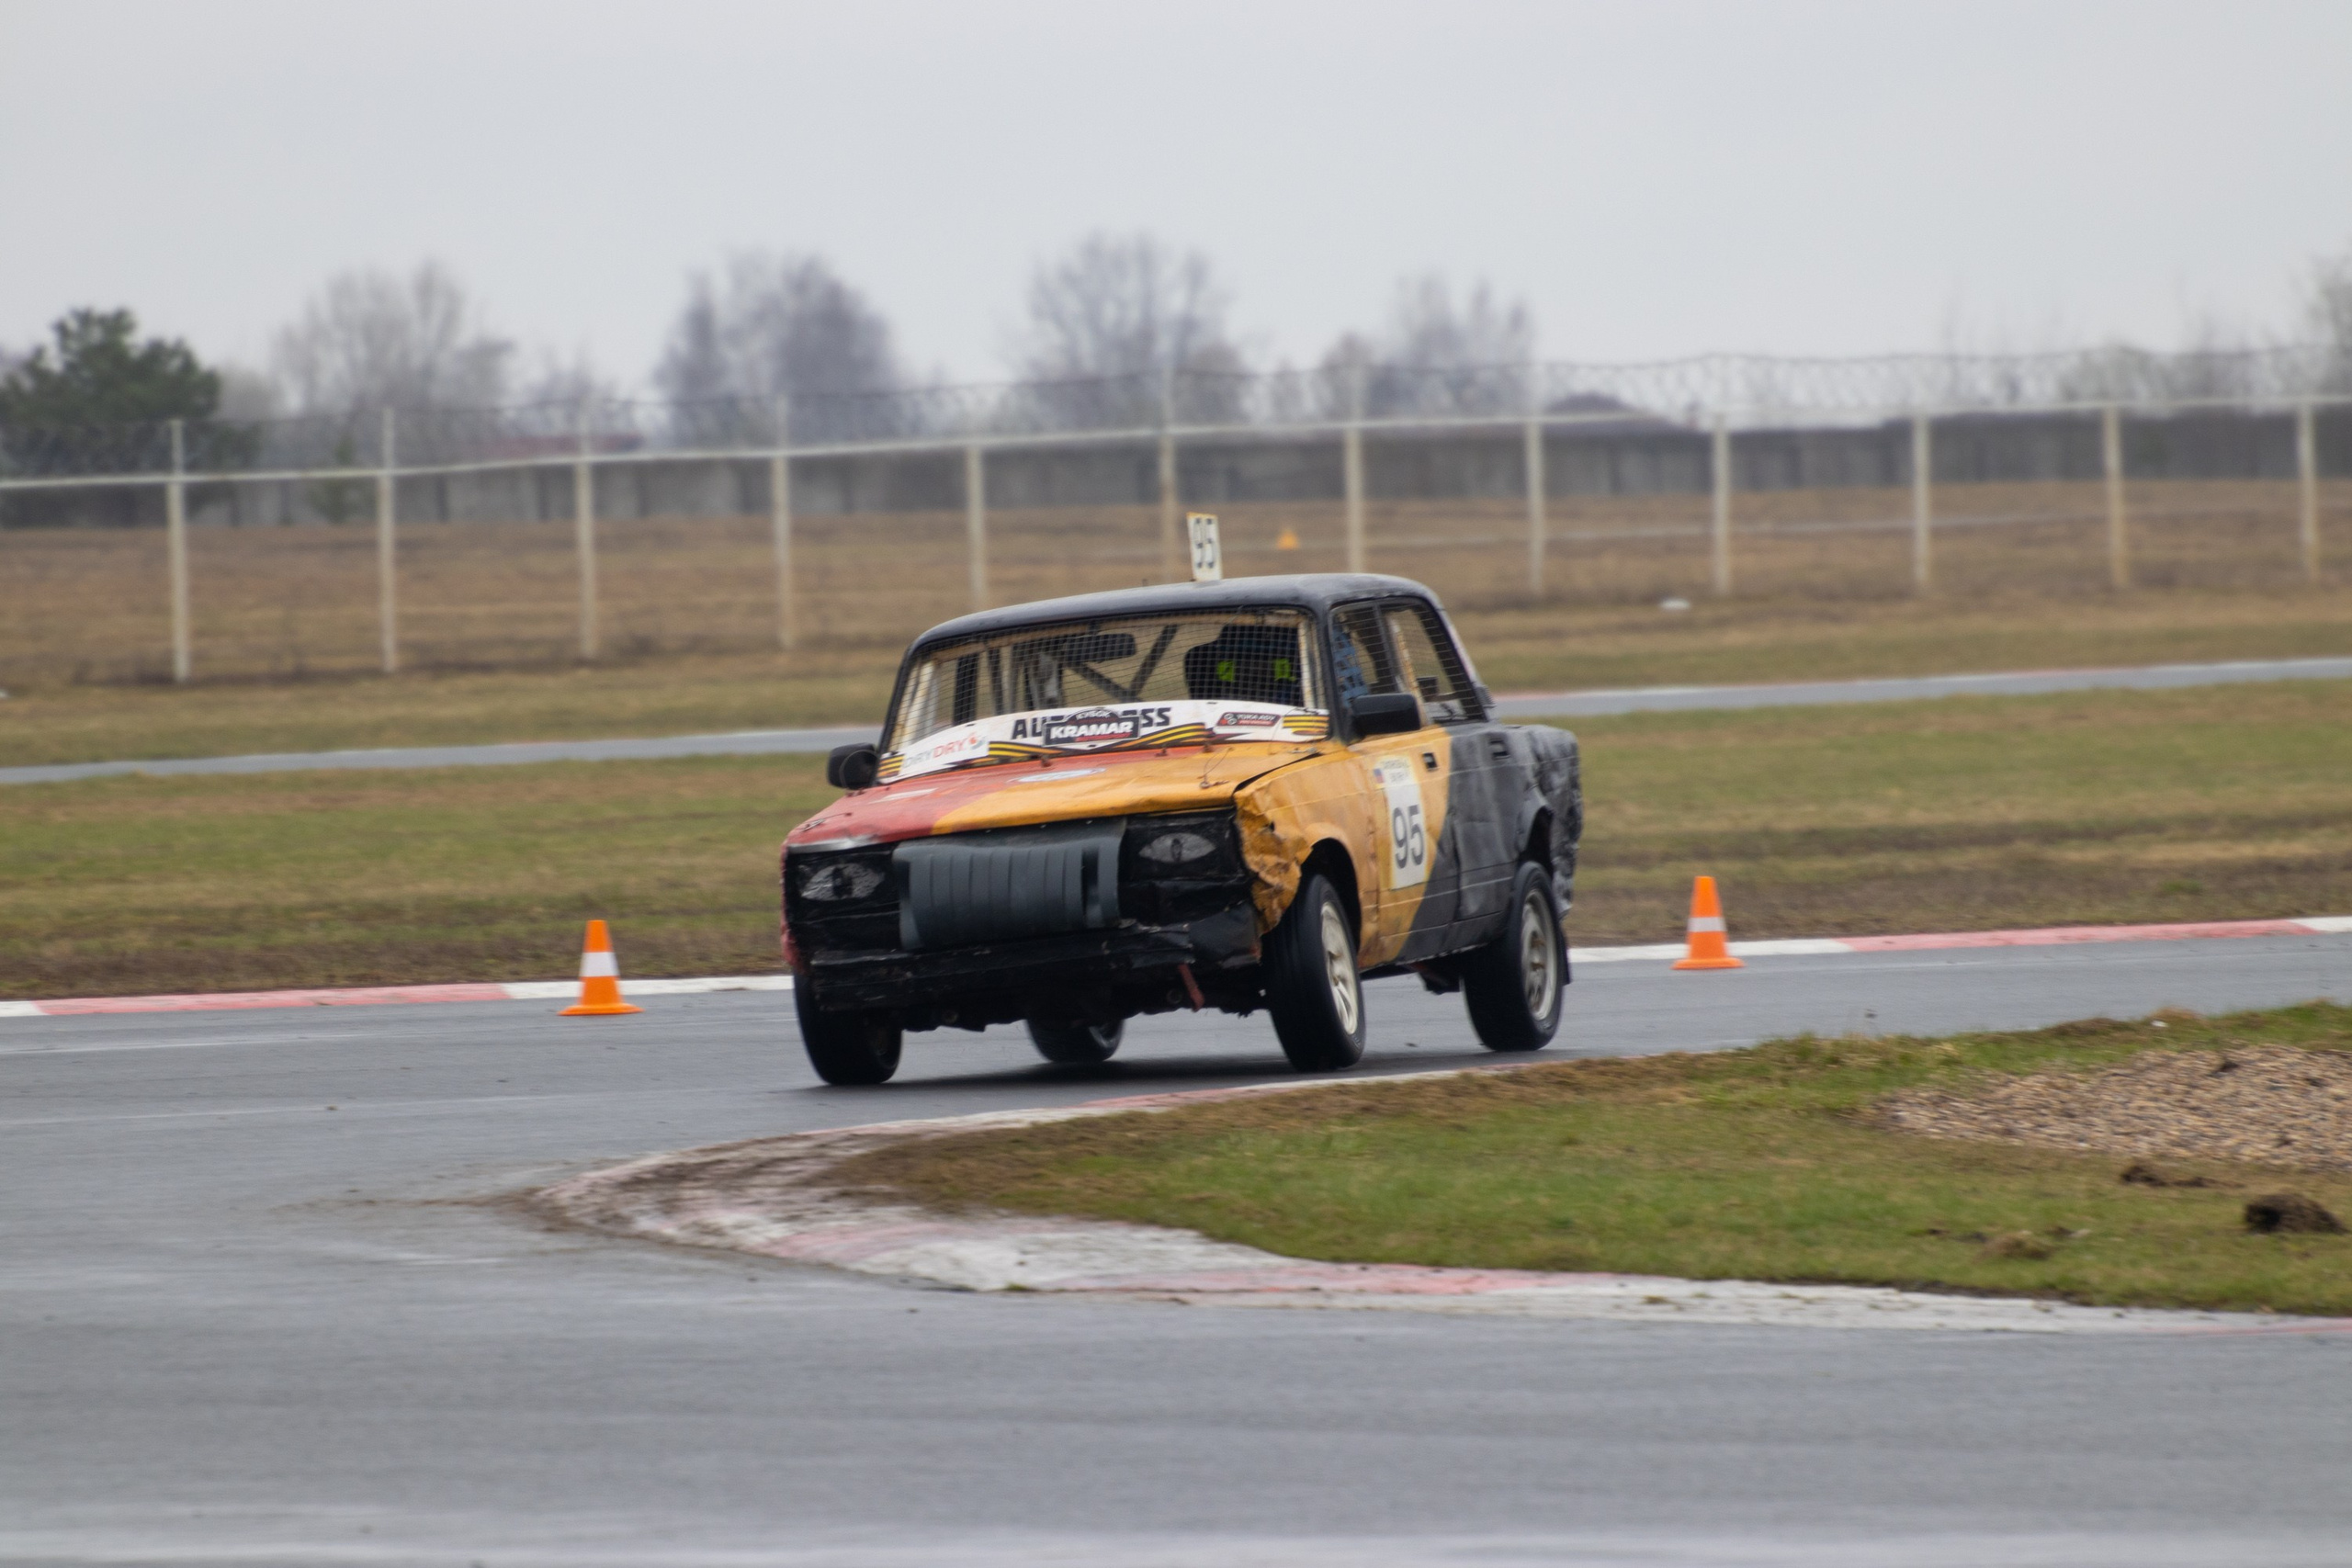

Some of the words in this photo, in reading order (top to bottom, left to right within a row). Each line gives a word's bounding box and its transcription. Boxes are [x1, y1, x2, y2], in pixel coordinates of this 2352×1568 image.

[1193, 518, 1216, 569] 95
[1050, 721, 1134, 739] KRAMAR
[1393, 804, 1424, 869] 95
